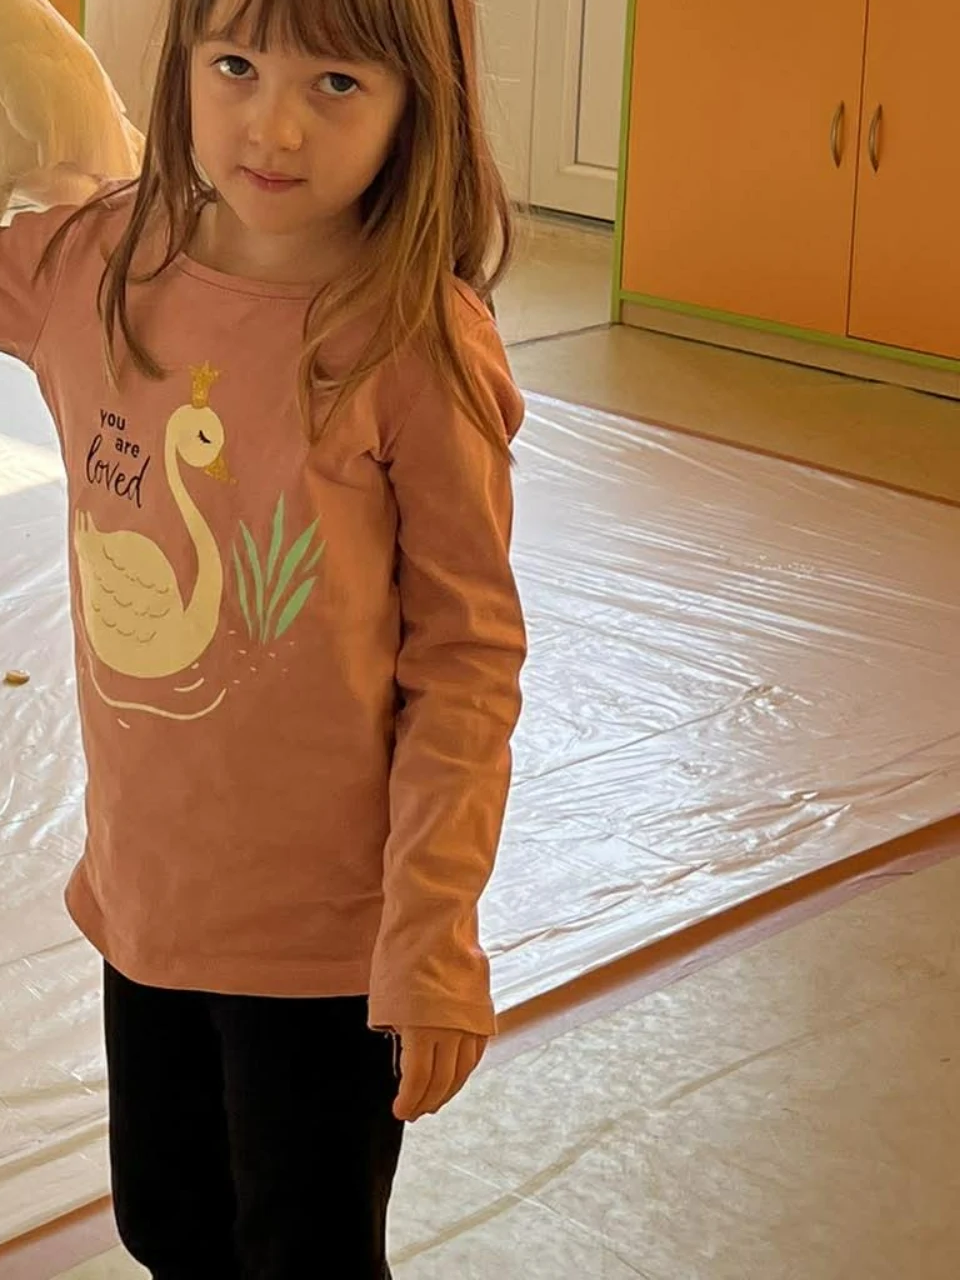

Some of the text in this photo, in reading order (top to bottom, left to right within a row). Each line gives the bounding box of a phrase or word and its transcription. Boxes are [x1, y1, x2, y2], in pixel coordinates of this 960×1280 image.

[100, 408, 126, 431] you
[115, 437, 141, 458] are
[86, 433, 151, 509] loved
